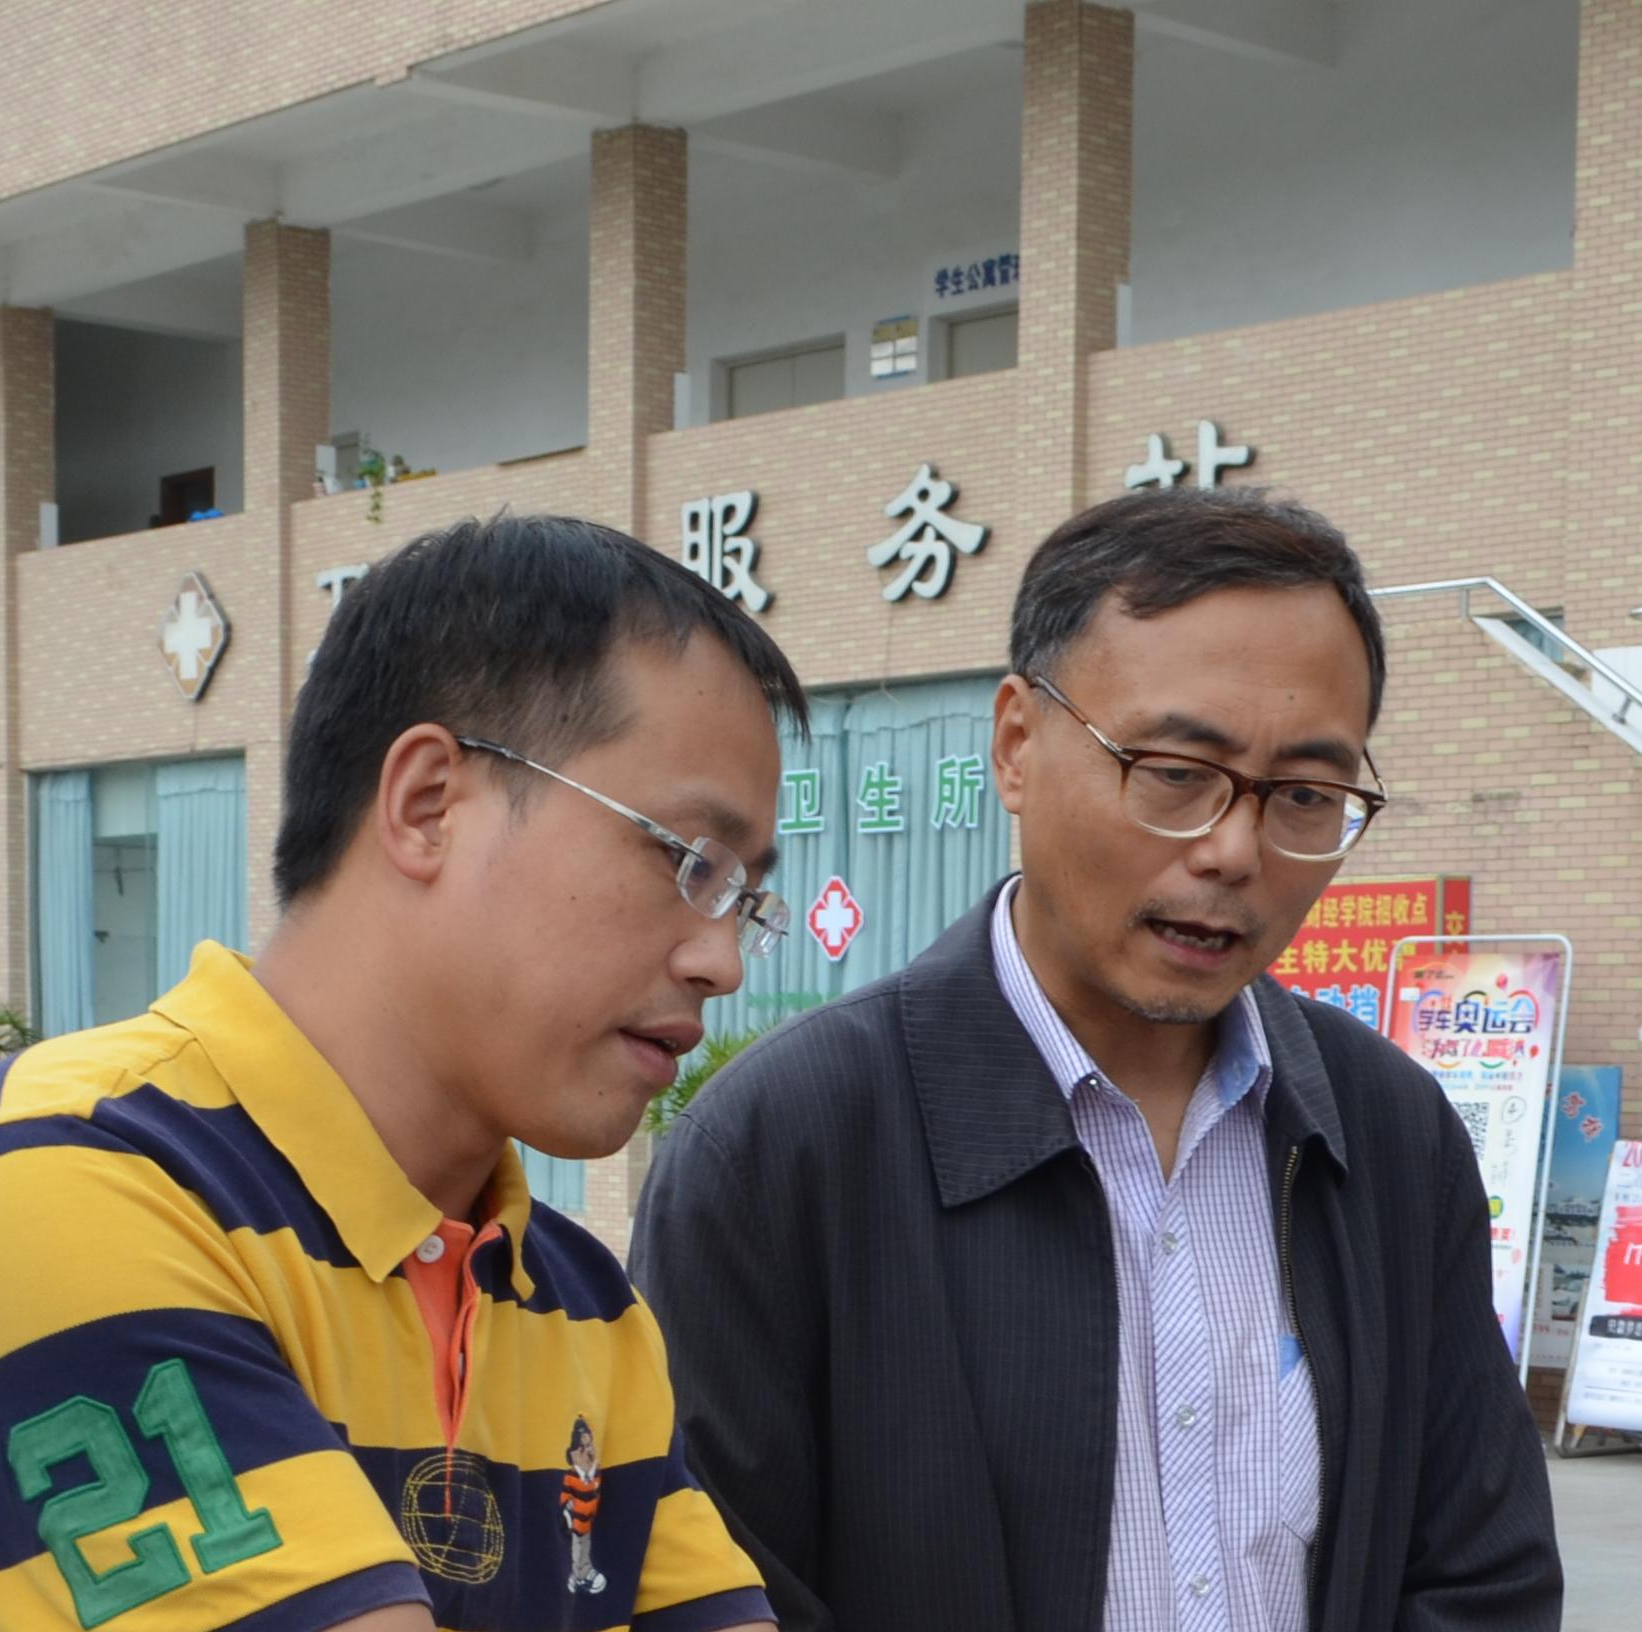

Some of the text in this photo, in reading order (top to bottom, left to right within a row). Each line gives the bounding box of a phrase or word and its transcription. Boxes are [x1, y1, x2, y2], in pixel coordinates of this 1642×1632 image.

[778, 753, 985, 834] 卫生所
[8, 1357, 283, 1631] 21
